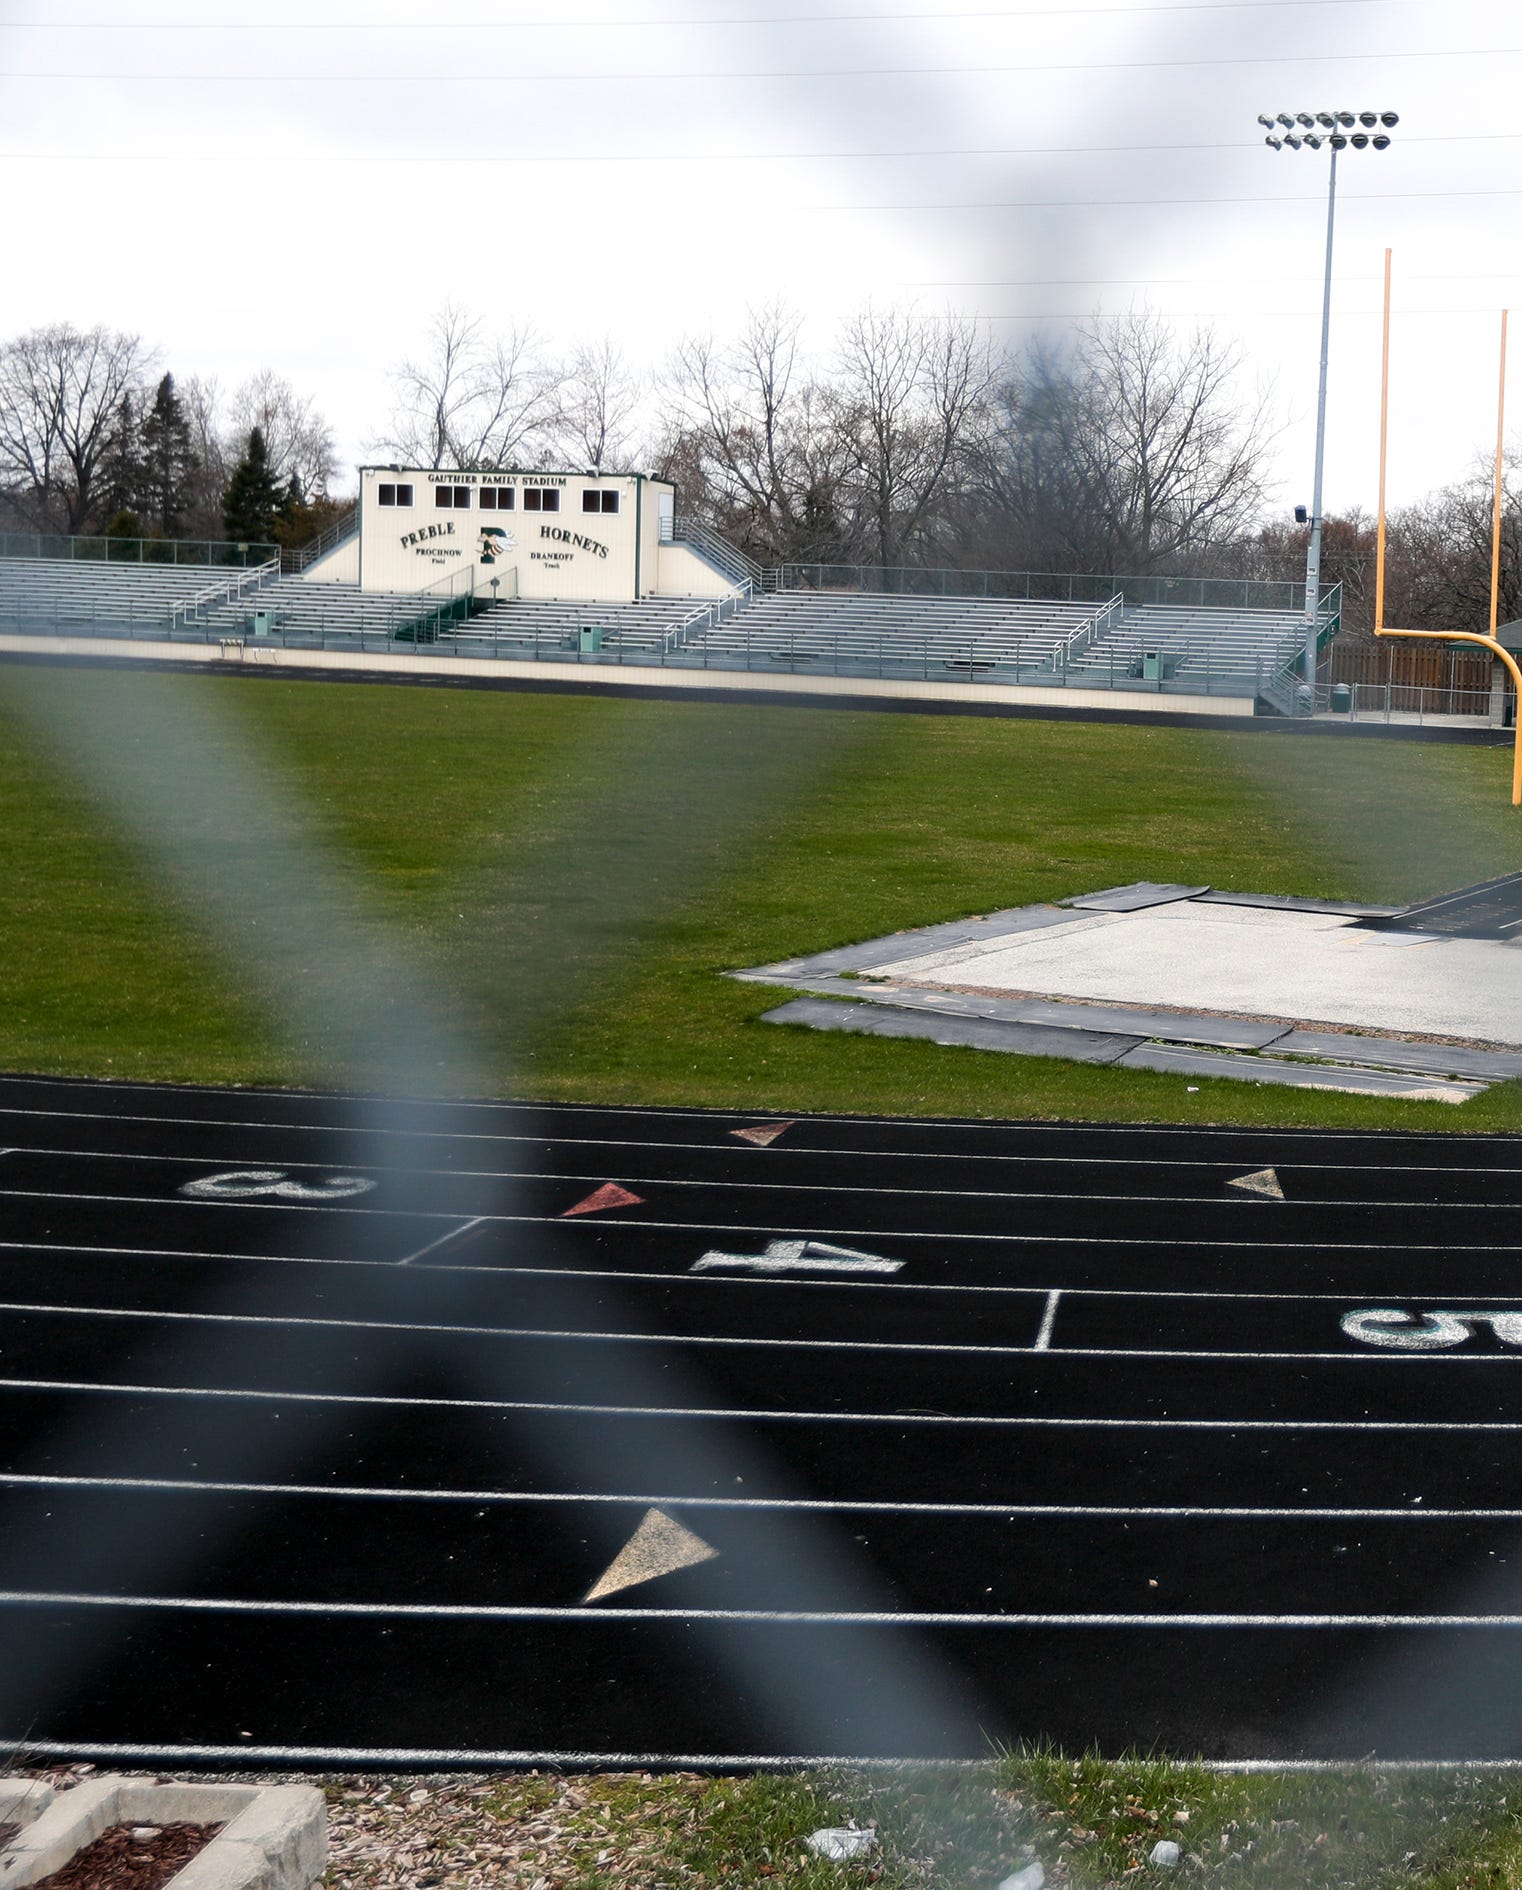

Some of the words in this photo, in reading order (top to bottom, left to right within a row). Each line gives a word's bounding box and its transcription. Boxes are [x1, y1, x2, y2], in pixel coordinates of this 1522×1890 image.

[428, 474, 477, 484] GAUTHIER
[482, 475, 518, 485] FAMILY
[522, 477, 567, 486] STADIUM
[400, 521, 456, 549] PREBLE
[540, 525, 609, 559] HORNETS
[177, 1171, 378, 1199] 3
[688, 1239, 908, 1273] 4
